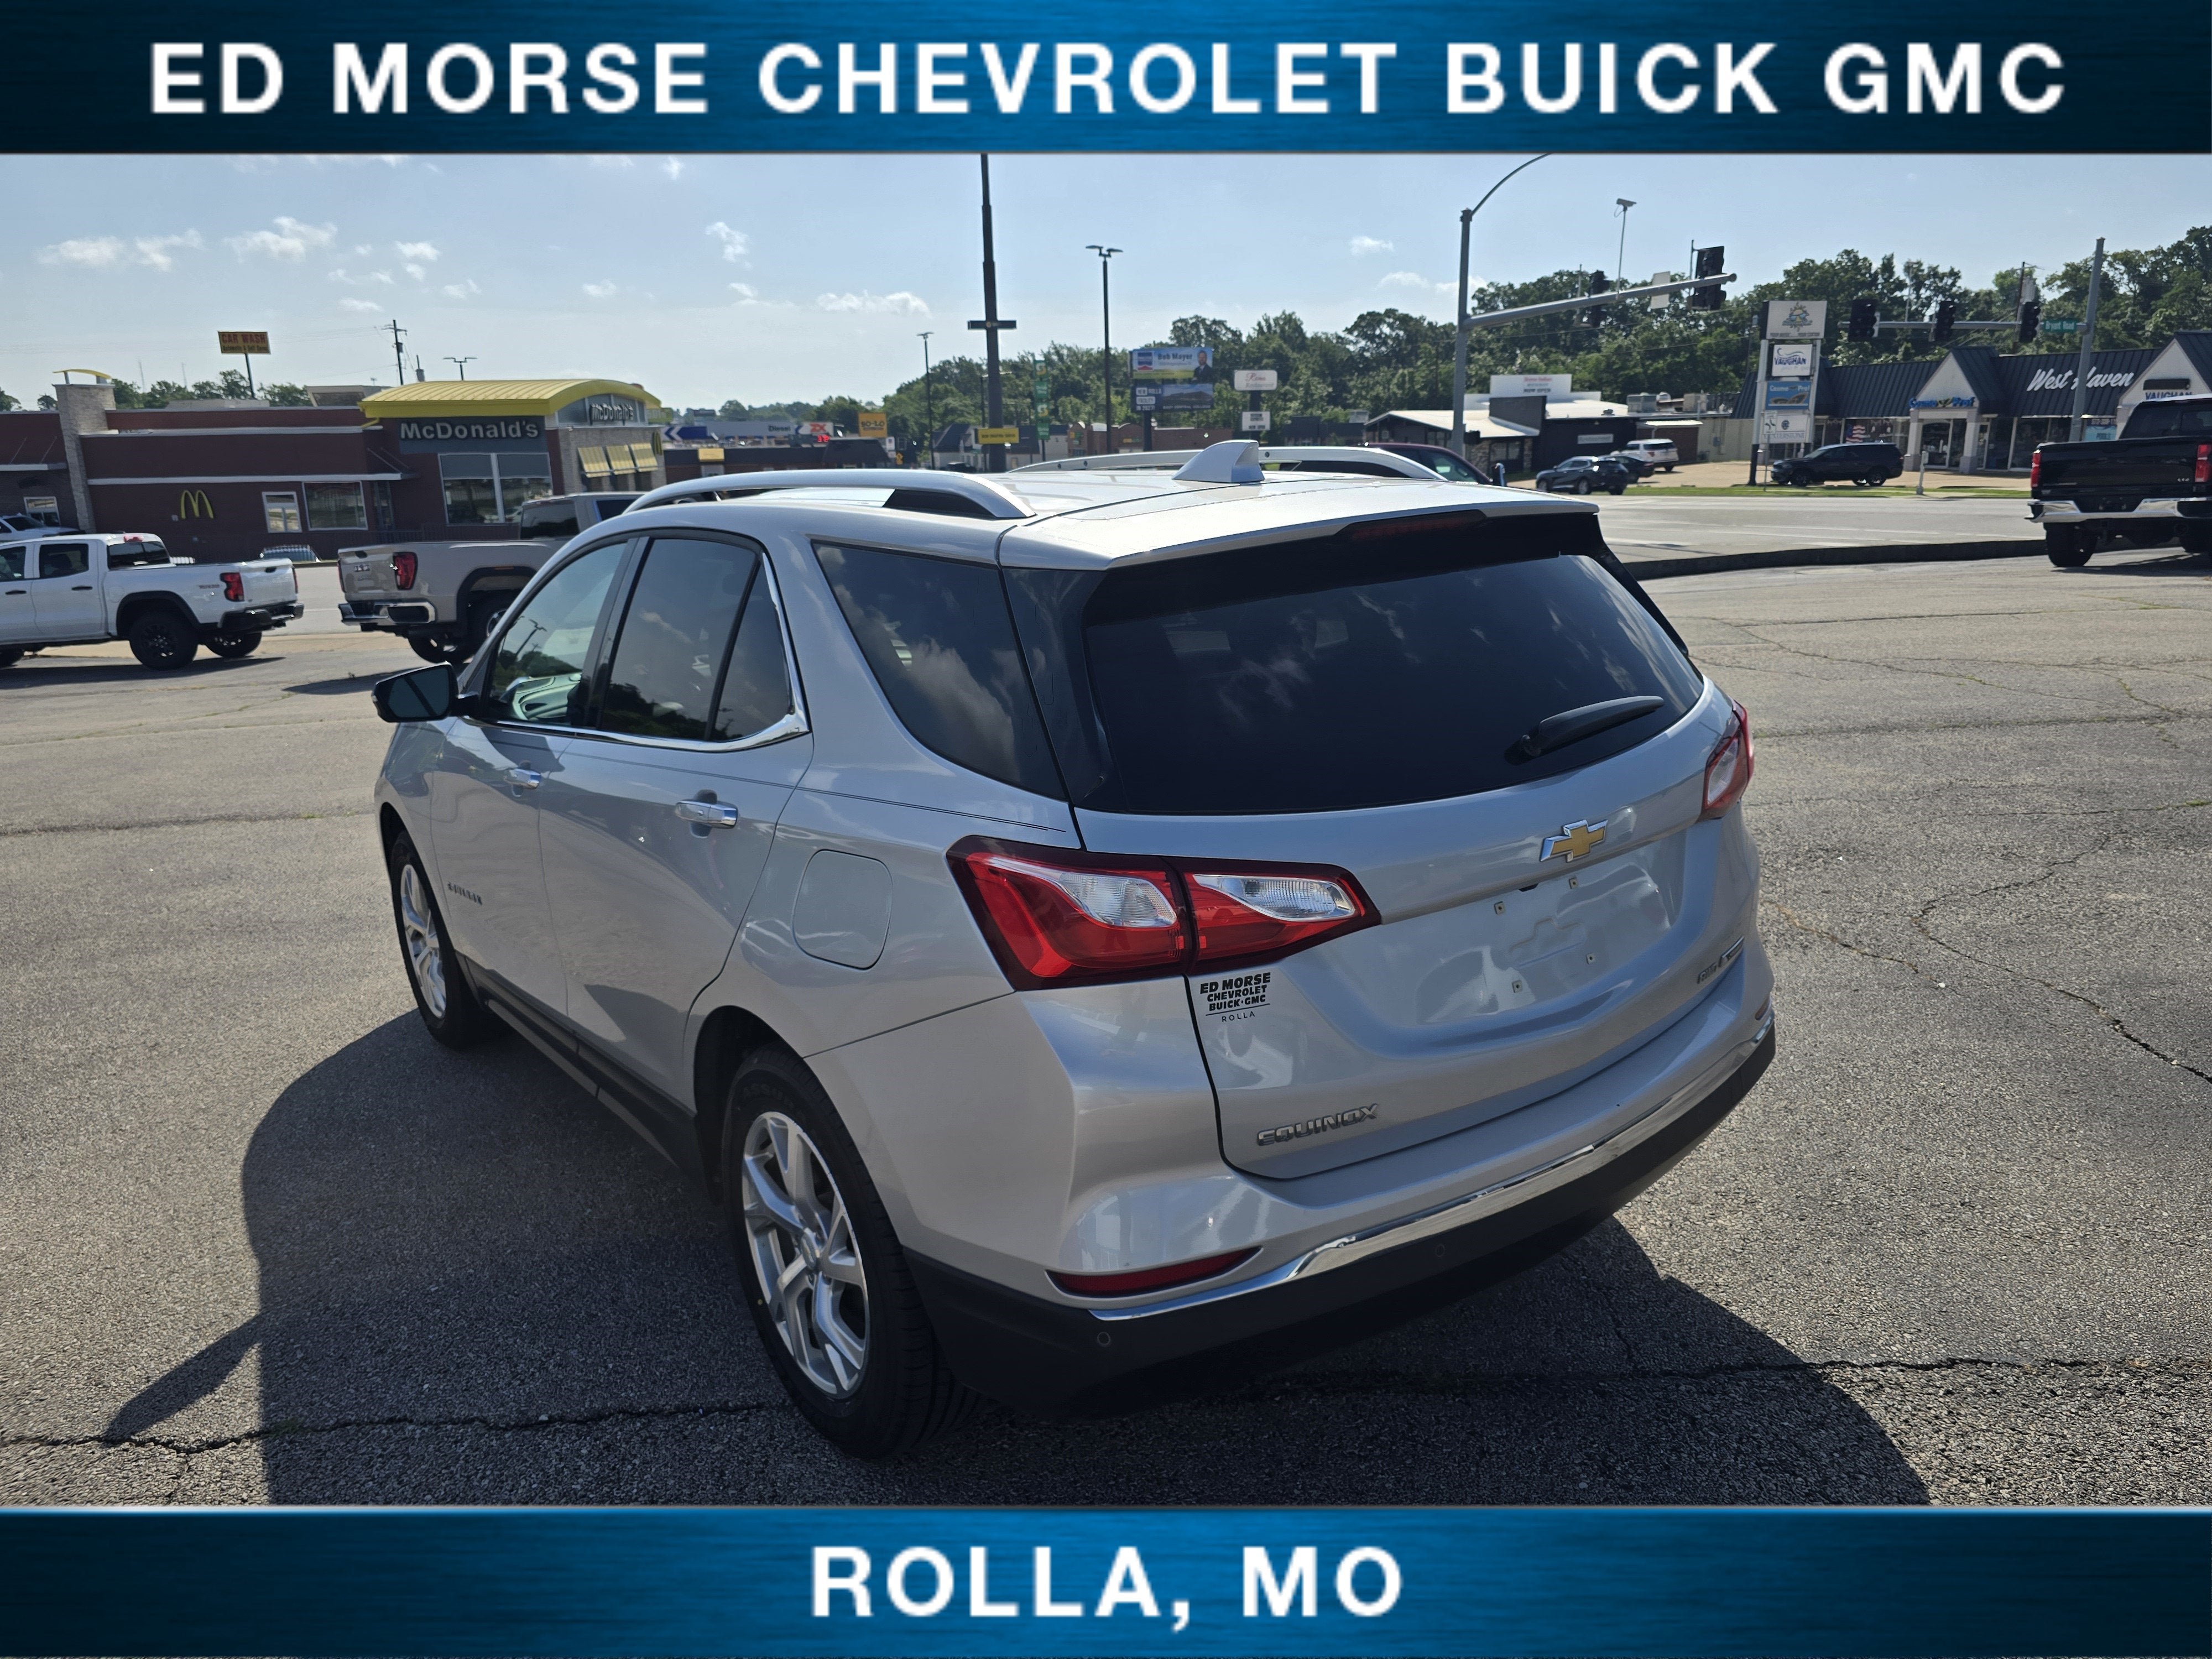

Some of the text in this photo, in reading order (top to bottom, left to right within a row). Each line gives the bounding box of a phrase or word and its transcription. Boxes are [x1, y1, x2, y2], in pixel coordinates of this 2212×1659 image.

[222, 334, 266, 343] CAR WASH
[2027, 368, 2073, 392] West
[401, 421, 539, 439] McDonald's
[1200, 972, 1271, 994] ED MORSE
[1207, 984, 1267, 1002] CHEVROLET
[1222, 1011, 1255, 1022] ROLLA
[1257, 1103, 1379, 1146] EQUINOX
